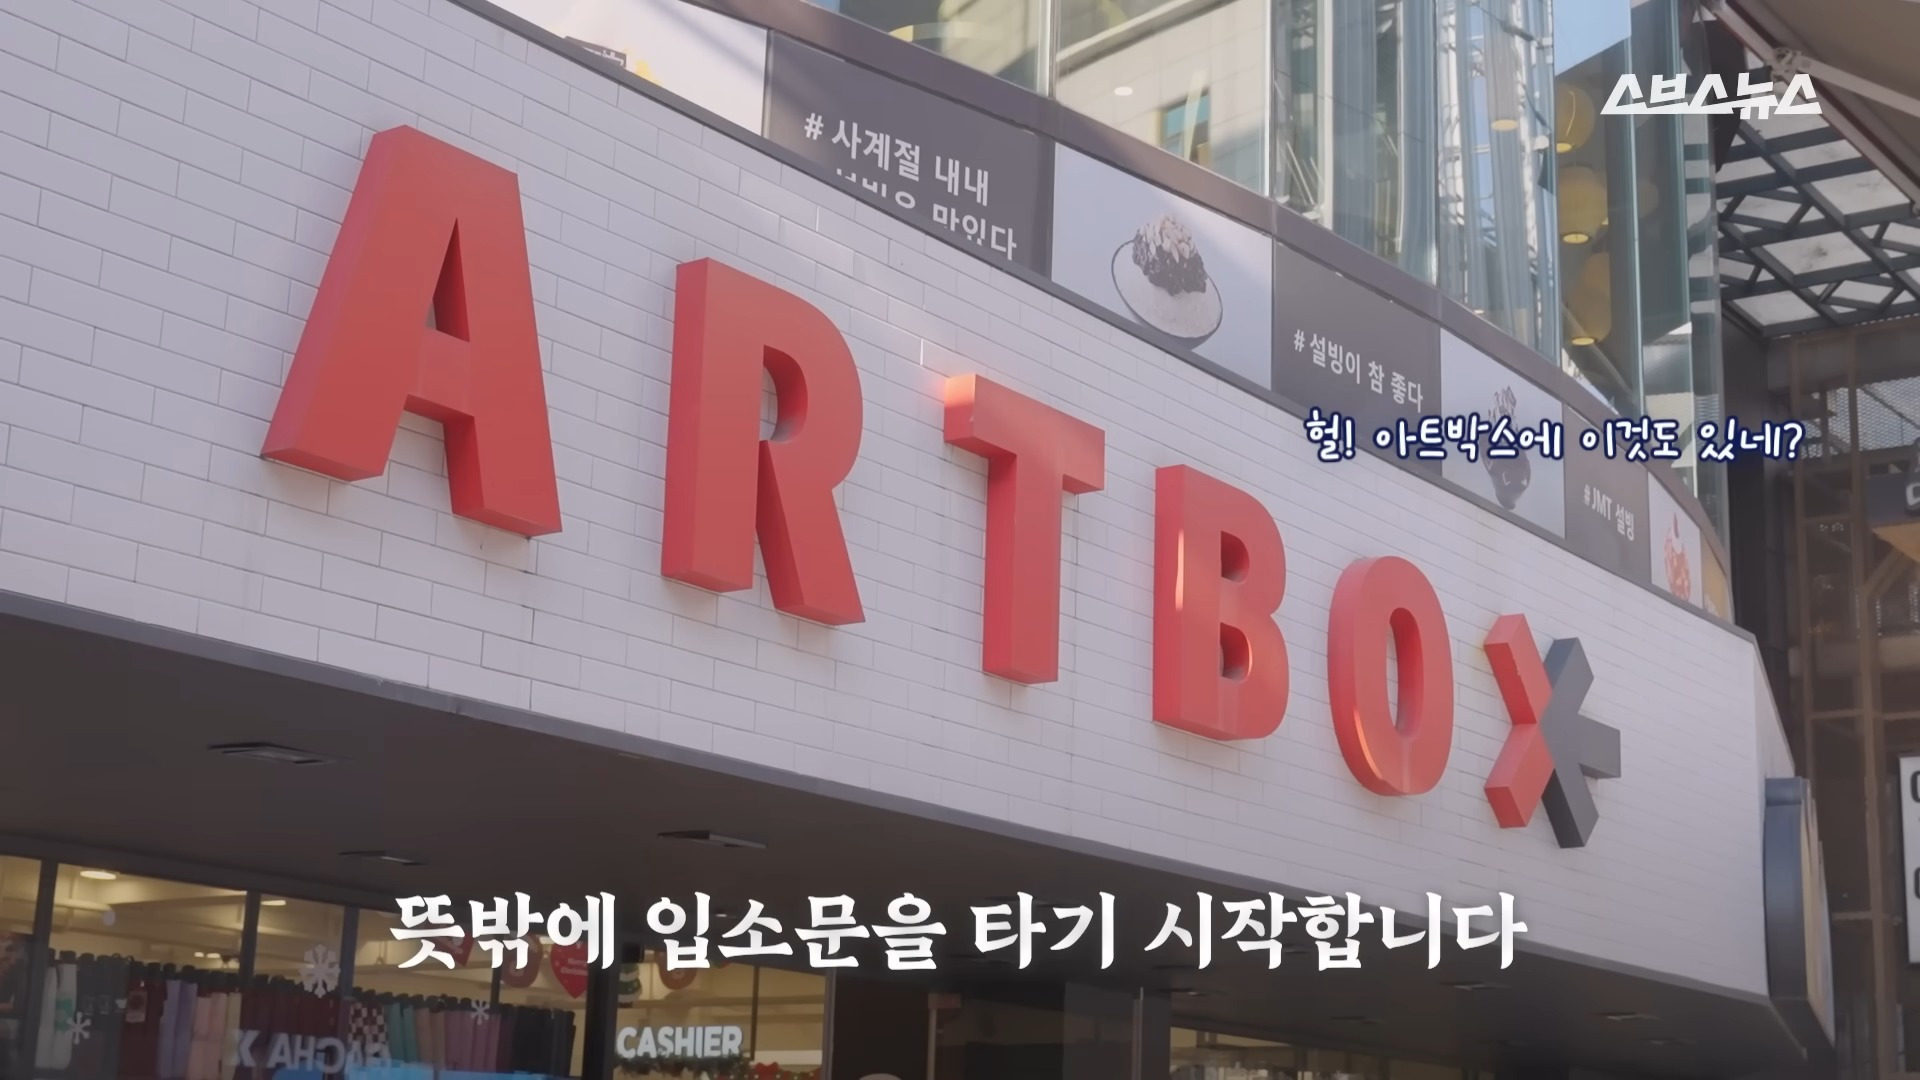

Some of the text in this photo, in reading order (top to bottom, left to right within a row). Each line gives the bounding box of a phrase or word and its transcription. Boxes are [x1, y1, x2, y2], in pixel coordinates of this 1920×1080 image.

[831, 119, 921, 183] 사계절
[934, 155, 989, 207] 내내
[1310, 333, 1360, 385] 설빙이
[1368, 360, 1385, 395] 참
[1391, 371, 1424, 414] 좋다
[262, 123, 1622, 848] ARTBOX
[1592, 487, 1612, 521] JMT
[1615, 503, 1636, 541] 설빙
[616, 1025, 744, 1059] CASHIER
